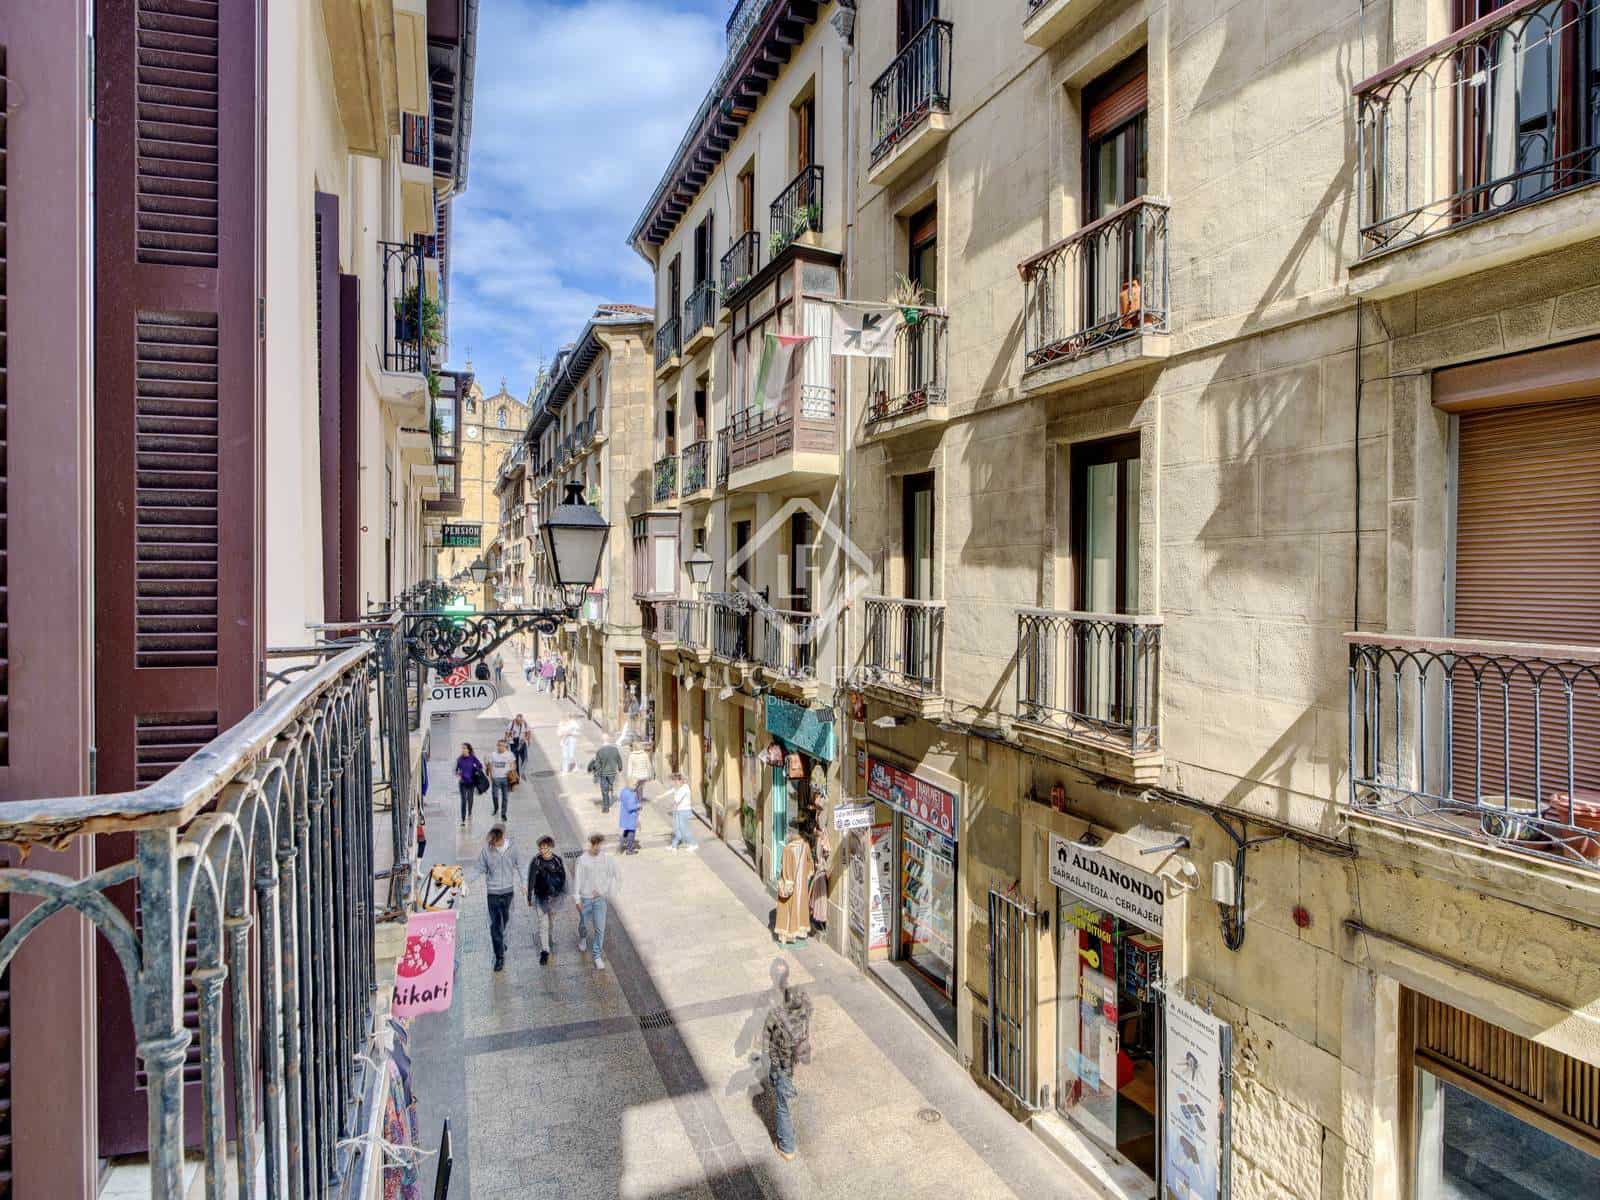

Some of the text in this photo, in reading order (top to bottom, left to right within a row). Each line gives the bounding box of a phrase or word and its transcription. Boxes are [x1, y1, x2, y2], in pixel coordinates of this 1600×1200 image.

[427, 686, 488, 701] OTERIA
[1072, 852, 1164, 905] ALDANONDO
[391, 980, 449, 1006] hikari
